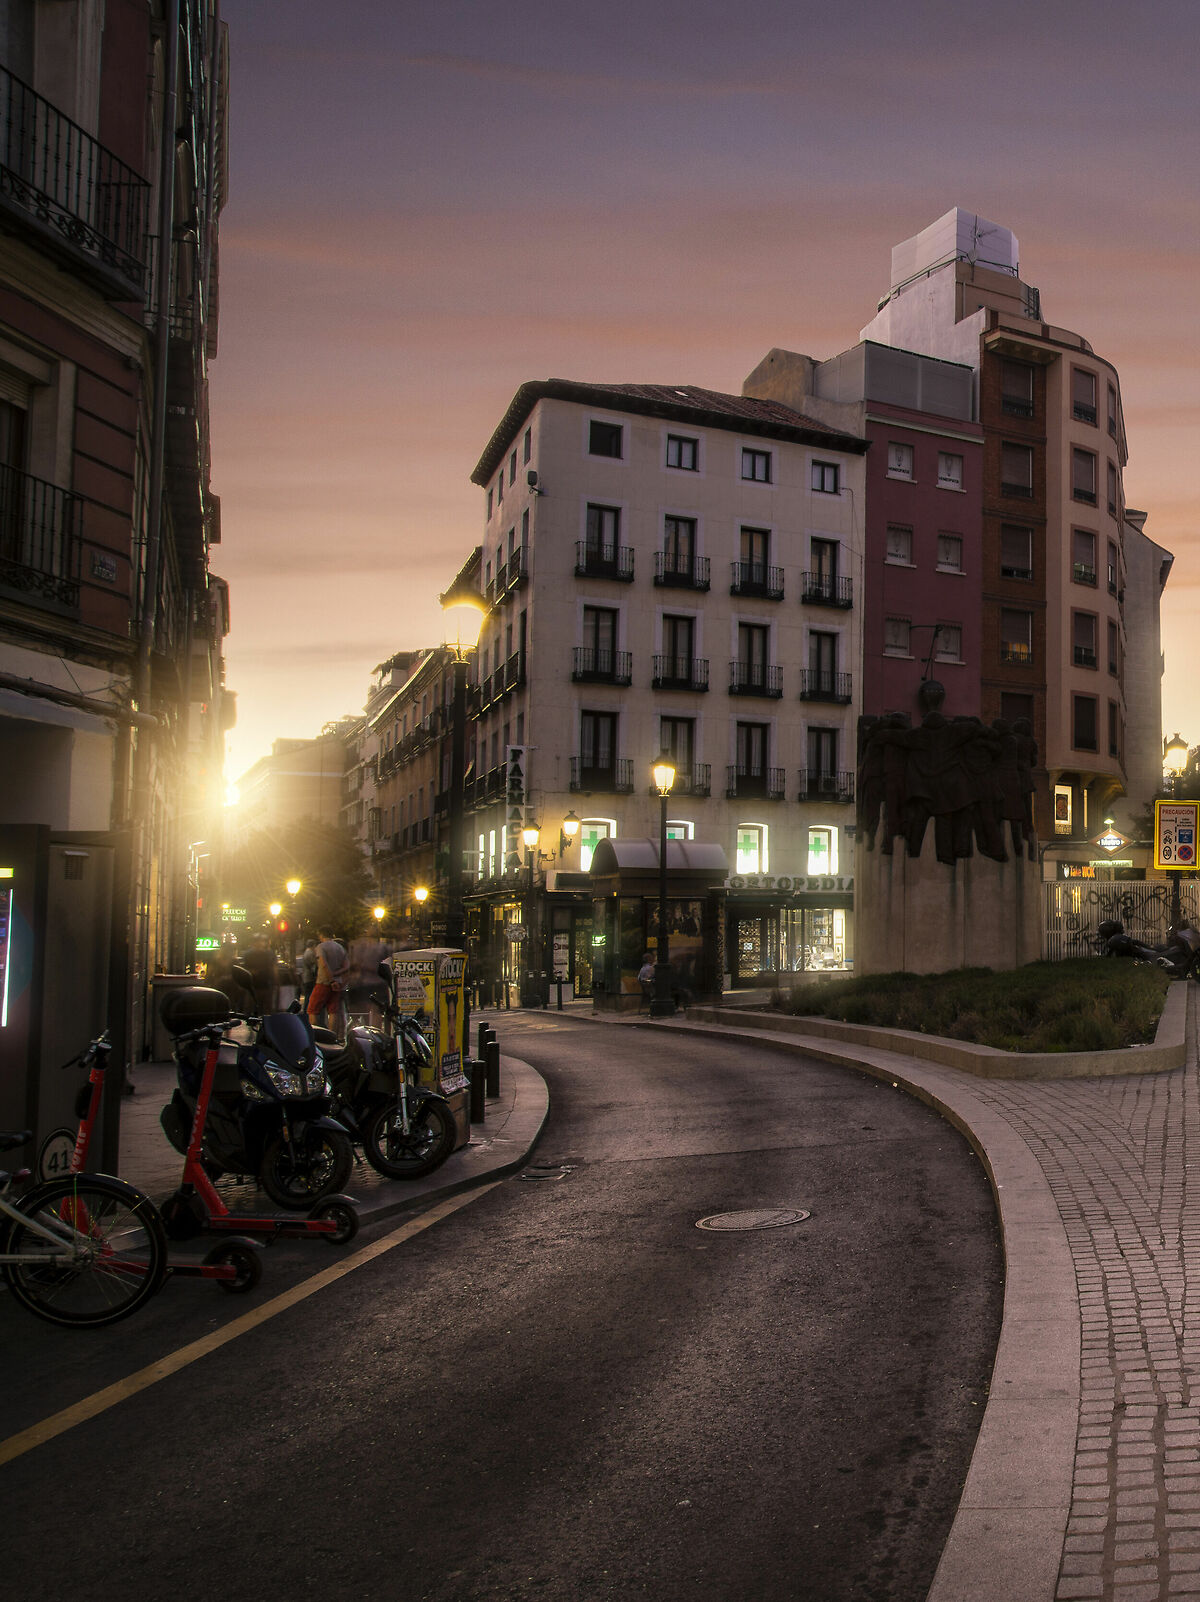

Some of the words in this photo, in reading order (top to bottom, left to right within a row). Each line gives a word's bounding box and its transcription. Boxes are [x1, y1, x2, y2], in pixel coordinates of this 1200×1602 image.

[507, 749, 524, 867] FARMACIA
[395, 962, 434, 972] STOCK!
[48, 1150, 70, 1172] 41
